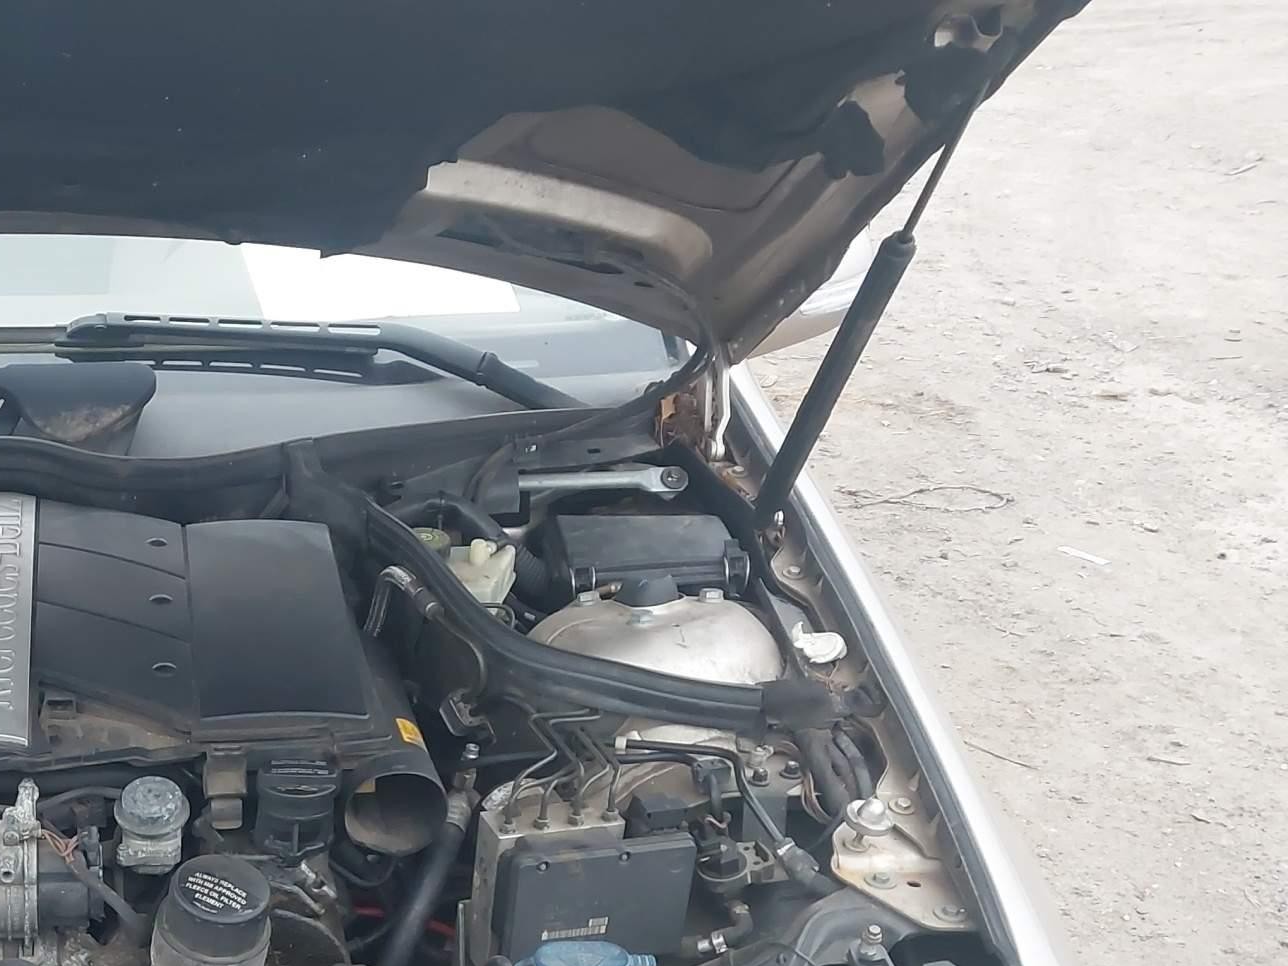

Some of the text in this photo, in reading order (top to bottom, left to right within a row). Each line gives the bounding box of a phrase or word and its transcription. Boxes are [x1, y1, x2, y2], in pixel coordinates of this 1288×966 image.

[185, 882, 209, 894] FLEECE
[219, 895, 242, 910] FILTER
[188, 876, 203, 885] WITH
[214, 885, 247, 905] APPROVED
[194, 872, 248, 898] ALWAYS REPLACE
[194, 892, 225, 909] ELEMENT
